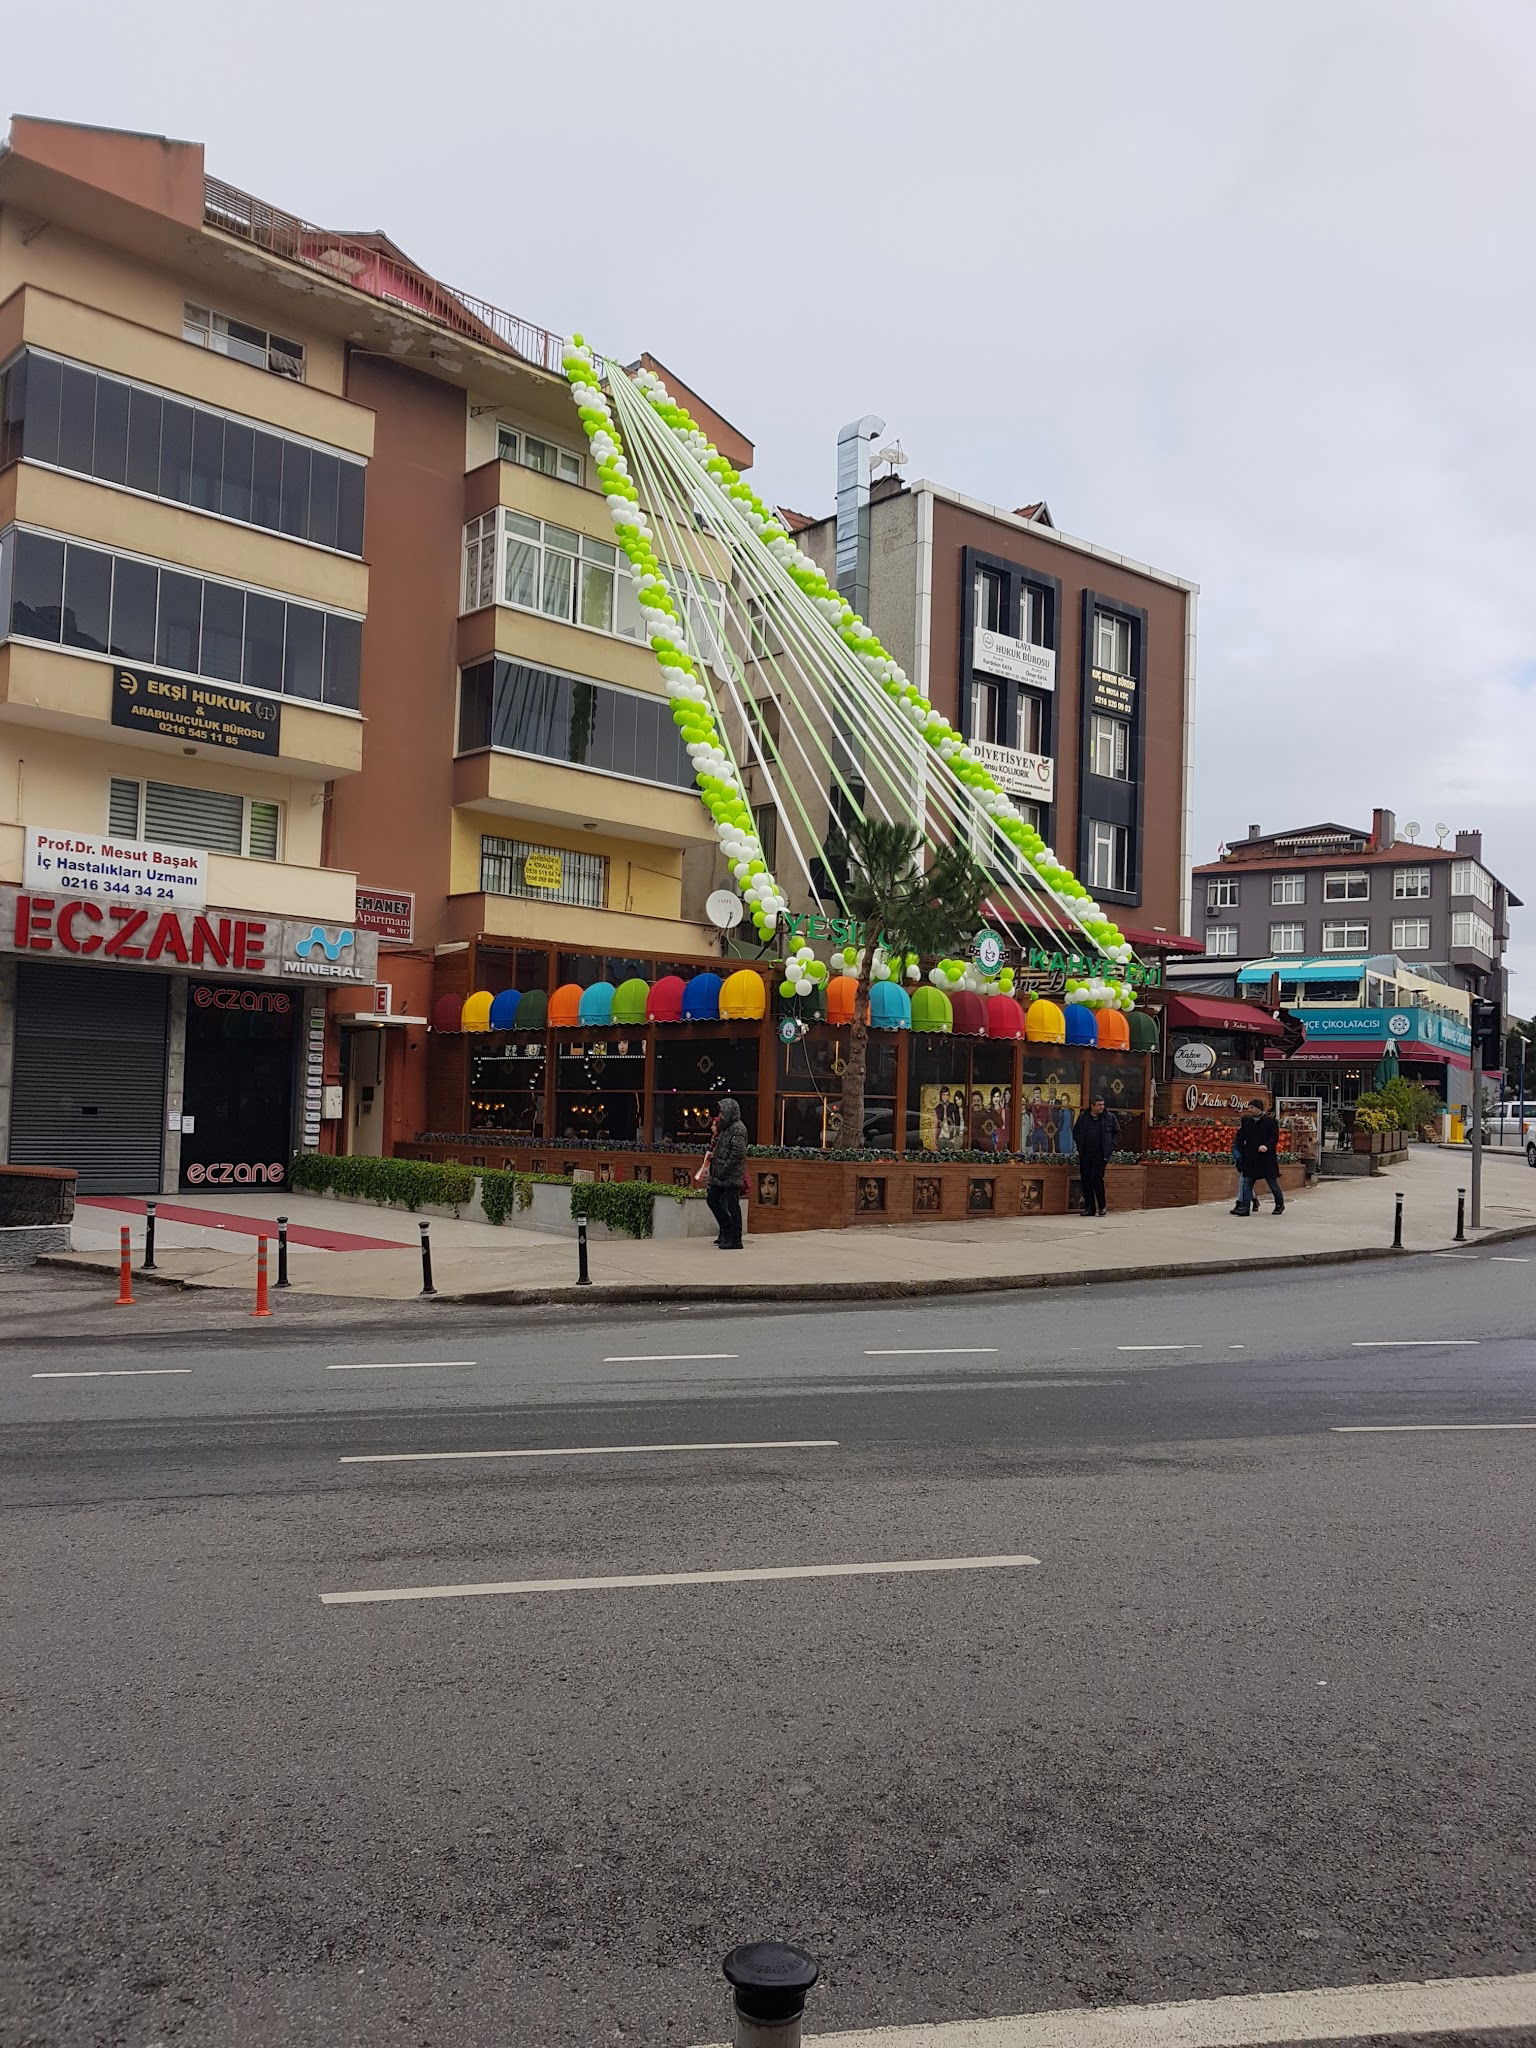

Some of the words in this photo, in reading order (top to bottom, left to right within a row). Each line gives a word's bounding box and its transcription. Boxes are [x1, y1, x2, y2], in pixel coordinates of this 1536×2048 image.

[996, 644, 1021, 660] HUKUK
[1022, 652, 1050, 668] BÜROSU
[1015, 640, 1032, 652] KAYA
[147, 680, 187, 701] EKŞİ
[192, 690, 252, 714] HUKUK
[1094, 695, 1107, 706] 0216
[195, 706, 205, 716] &
[131, 705, 220, 731] ARABULUCULUK
[222, 723, 265, 740] BÜROSU
[159, 722, 185, 735] 0216
[188, 729, 207, 739] 545
[210, 733, 222, 742] 11
[225, 735, 239, 745] 85
[974, 745, 1035, 770] DİYETİSYEN
[37, 835, 95, 855] Prof.Dr.
[101, 845, 148, 862] Mesut
[153, 851, 198, 869] Başak
[37, 852, 51, 869] İç
[57, 857, 141, 878] Hastalıkları
[146, 869, 198, 886] Uzmanı
[61, 876, 98, 890] 0216
[103, 881, 130, 894] 344
[135, 885, 152, 896] 34
[157, 888, 174, 899] 24
[356, 896, 409, 915] EMANET
[356, 910, 410, 927] Apartmanı
[14, 895, 267, 970] ECZANE
[284, 957, 365, 979] MİNERAL
[1030, 948, 1117, 980] KAHVE
[1125, 963, 1162, 988] EVİ
[194, 987, 290, 1013] eczane
[377, 989, 386, 1010] E
[1322, 1019, 1380, 1031] ÇİKOLATACISI
[1176, 1049, 1201, 1059] Kahve
[1186, 1059, 1208, 1070] Diyarı
[1200, 1092, 1227, 1107] Kahve
[1230, 1094, 1250, 1112] Diya
[187, 1163, 284, 1183] eczane
